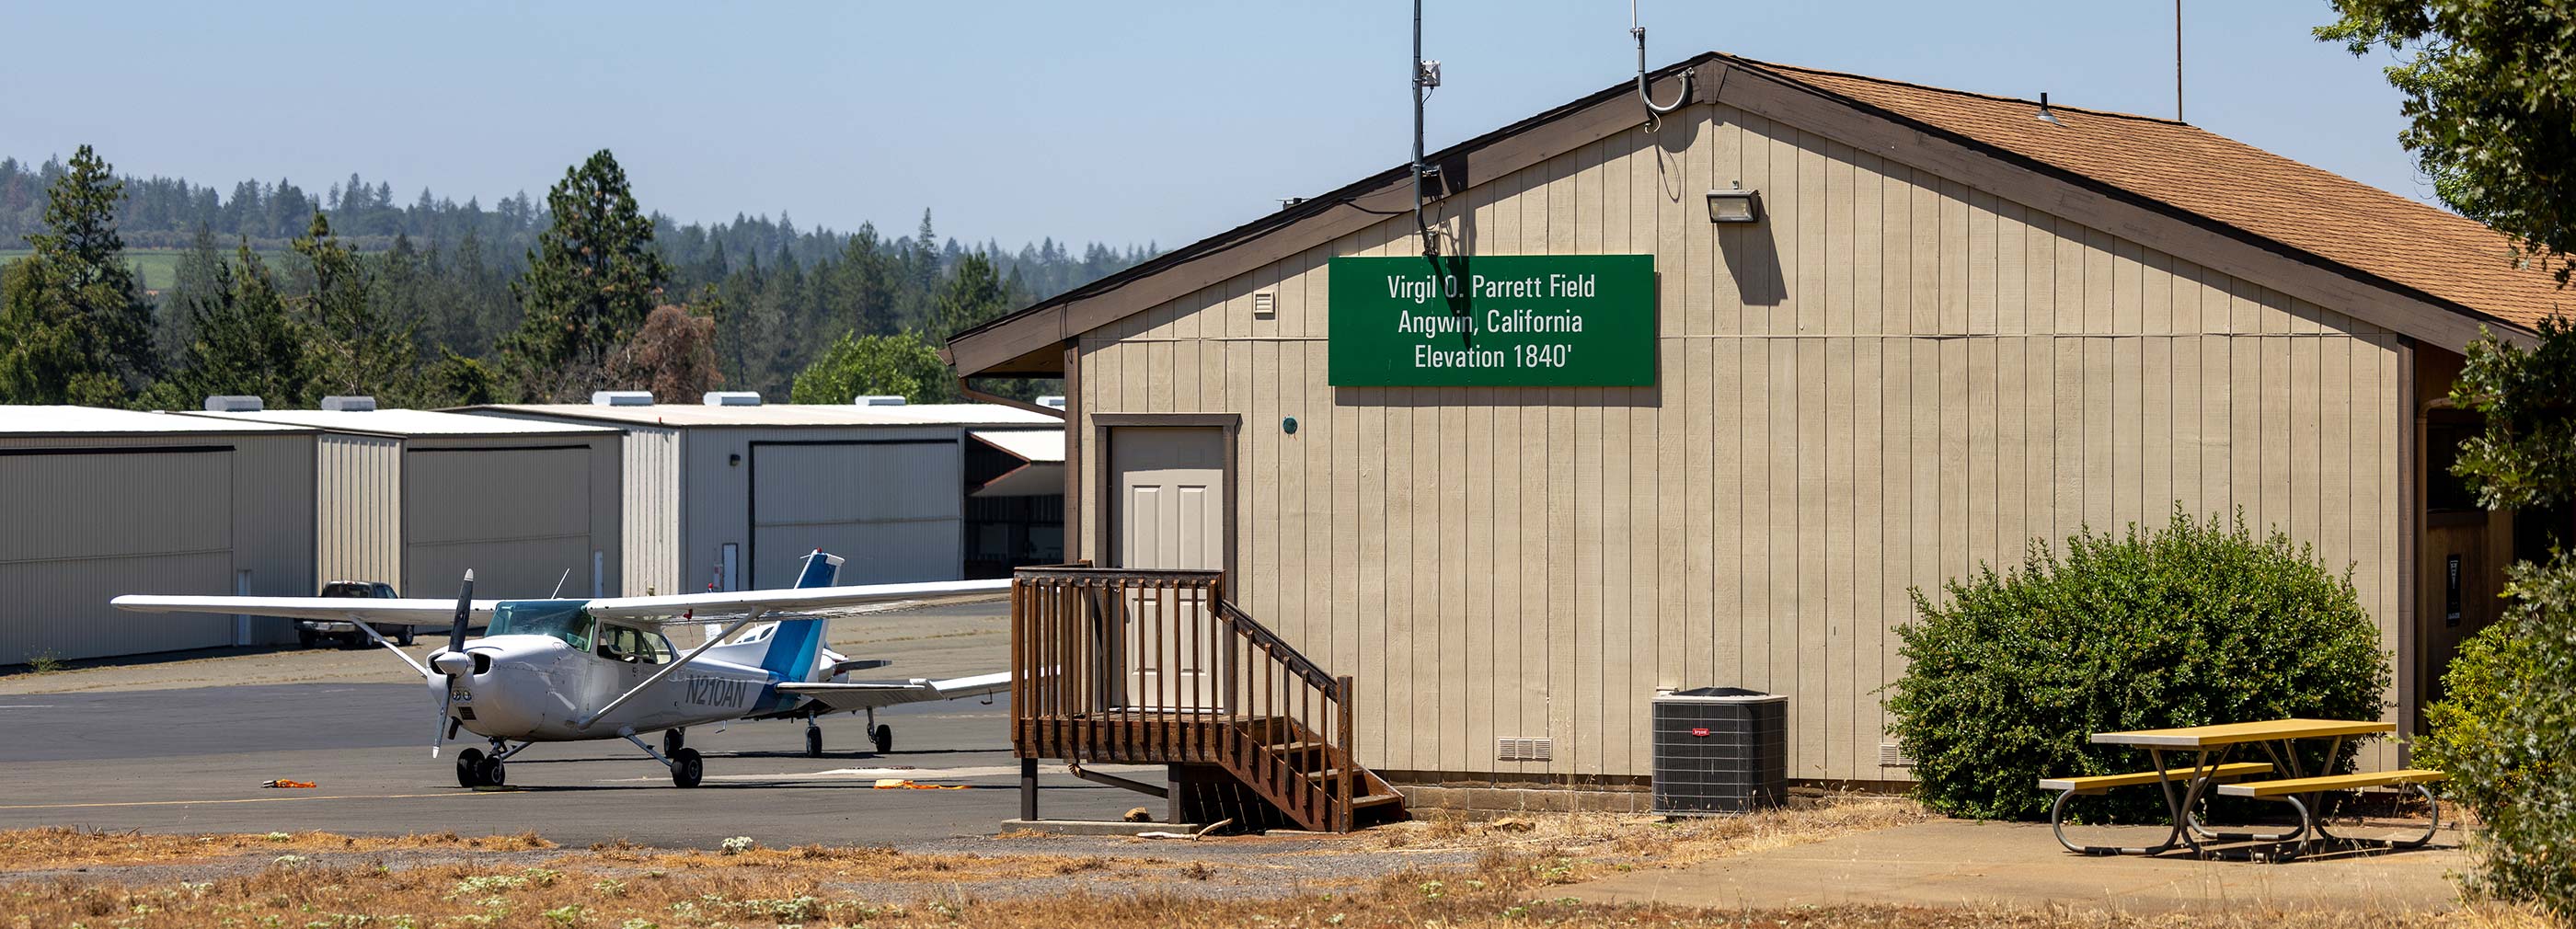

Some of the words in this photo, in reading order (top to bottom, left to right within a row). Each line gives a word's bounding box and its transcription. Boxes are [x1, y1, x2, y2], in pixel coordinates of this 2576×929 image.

[1387, 275, 1436, 304] Virgil
[1444, 274, 1464, 298] O.
[1472, 274, 1542, 298] Parrett
[1550, 274, 1595, 298] Field
[1397, 310, 1478, 339] Angwin,
[1487, 309, 1582, 333] California
[1415, 344, 1504, 368] Elevation
[1513, 344, 1572, 368] 1840'
[685, 674, 747, 708] N210AN
